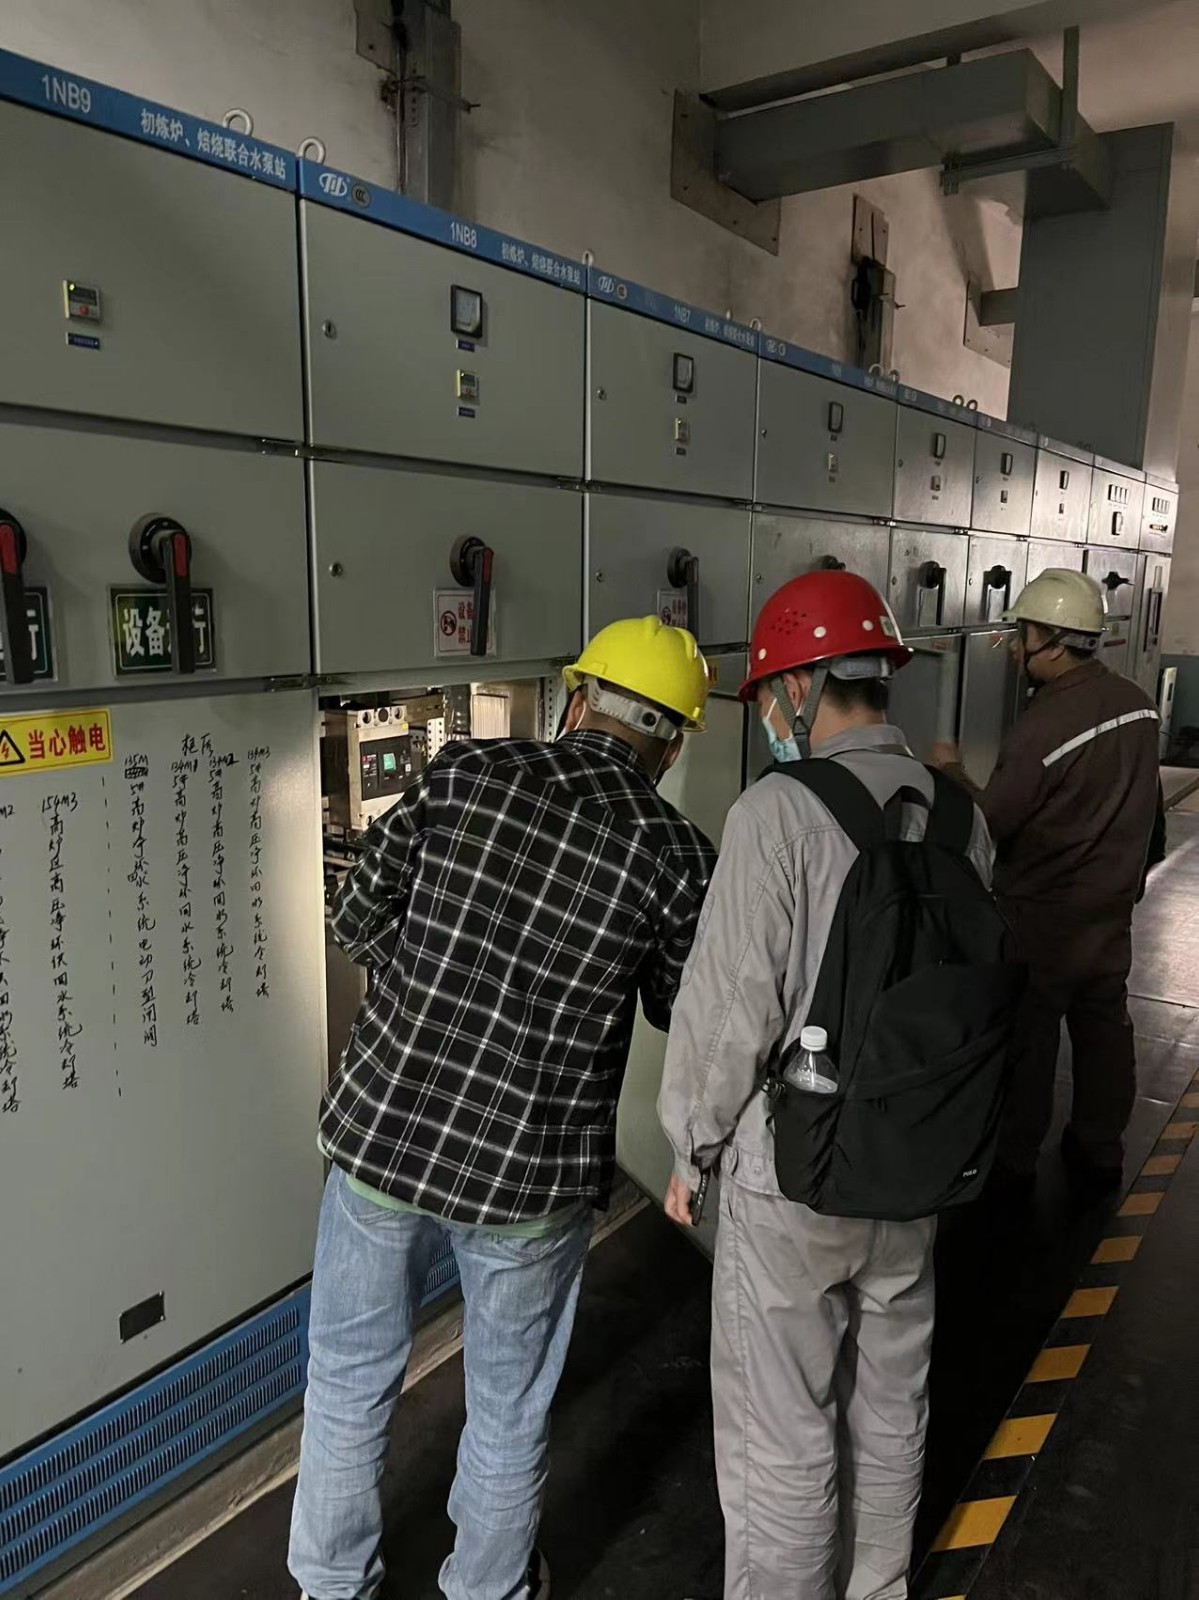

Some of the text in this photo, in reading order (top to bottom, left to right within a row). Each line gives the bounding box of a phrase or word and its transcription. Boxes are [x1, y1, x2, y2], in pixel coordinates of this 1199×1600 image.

[41, 74, 91, 114] 1NB9
[450, 222, 477, 248] 1NB8
[28, 722, 106, 759] 当心触电
